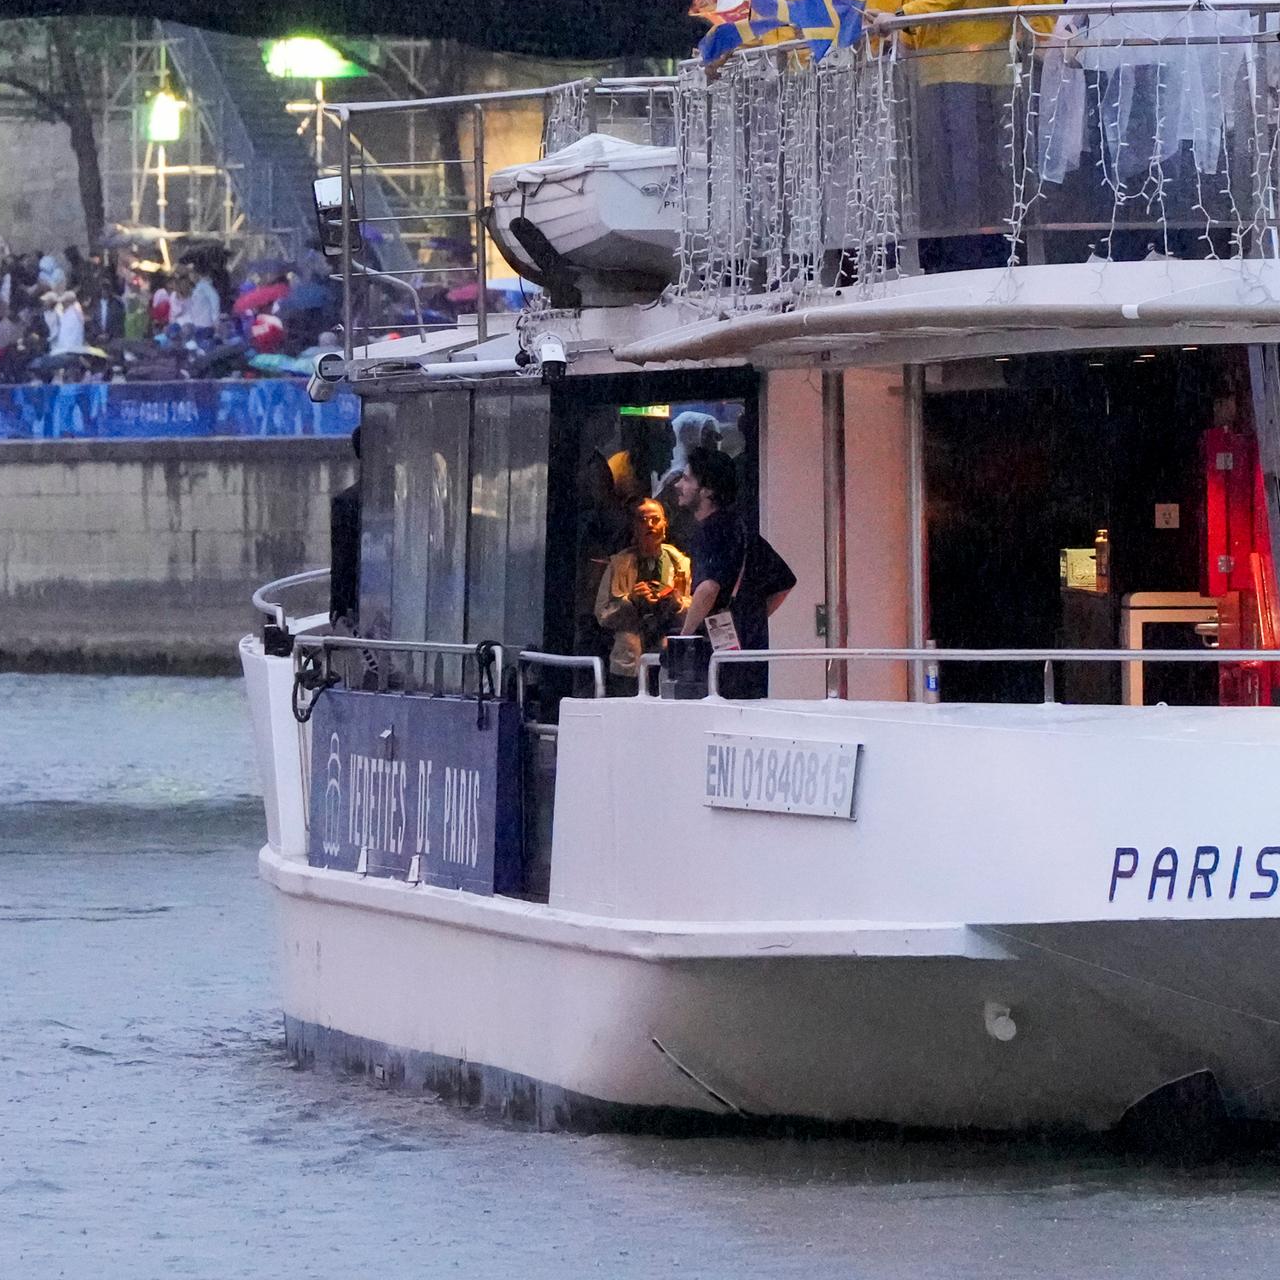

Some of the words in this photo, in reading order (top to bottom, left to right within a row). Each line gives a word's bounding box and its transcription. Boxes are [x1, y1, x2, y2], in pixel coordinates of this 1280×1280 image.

[349, 753, 407, 855] VEDETTES
[416, 759, 433, 855] DE
[442, 766, 480, 868] PARIS
[706, 744, 737, 798] ENI
[741, 747, 850, 808] 01840815
